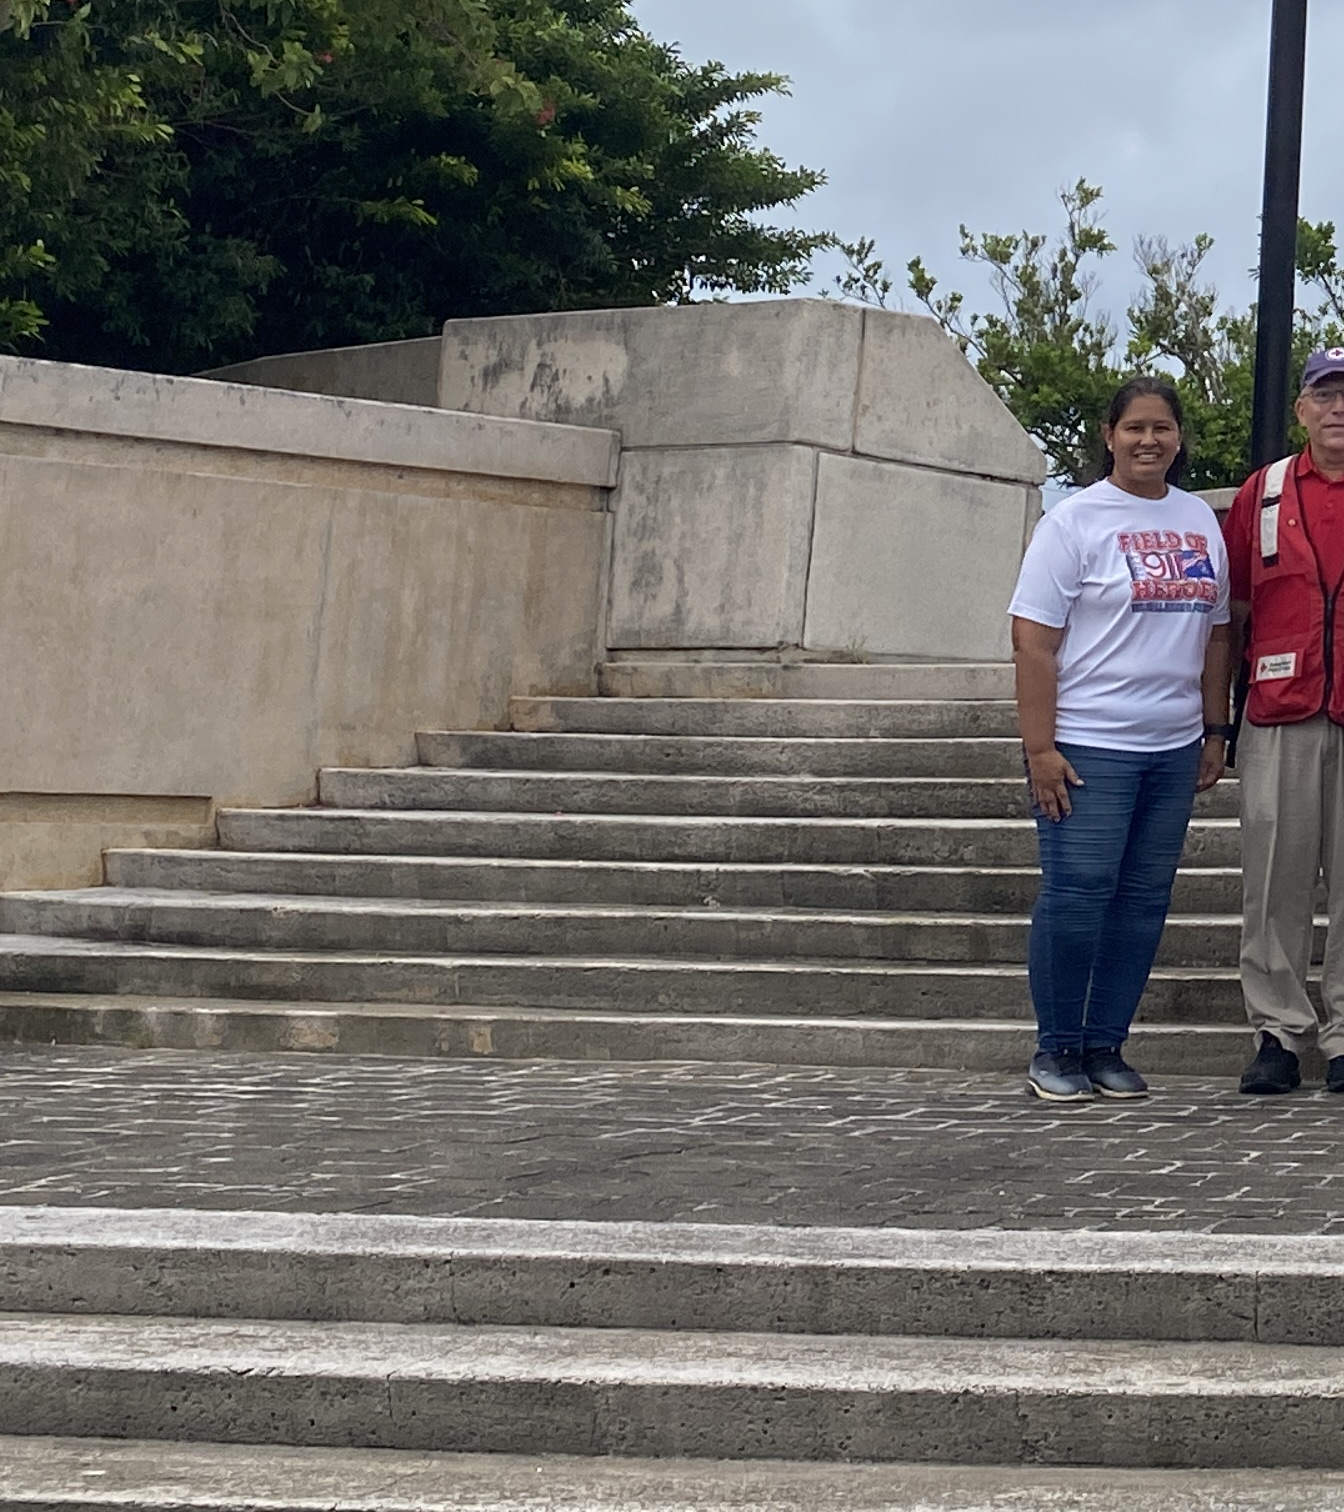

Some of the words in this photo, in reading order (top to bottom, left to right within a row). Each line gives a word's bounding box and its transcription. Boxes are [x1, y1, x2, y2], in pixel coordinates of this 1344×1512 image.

[1117, 531, 1182, 552] FIELD
[1184, 531, 1208, 552] OF
[1131, 579, 1218, 603] HEROES
